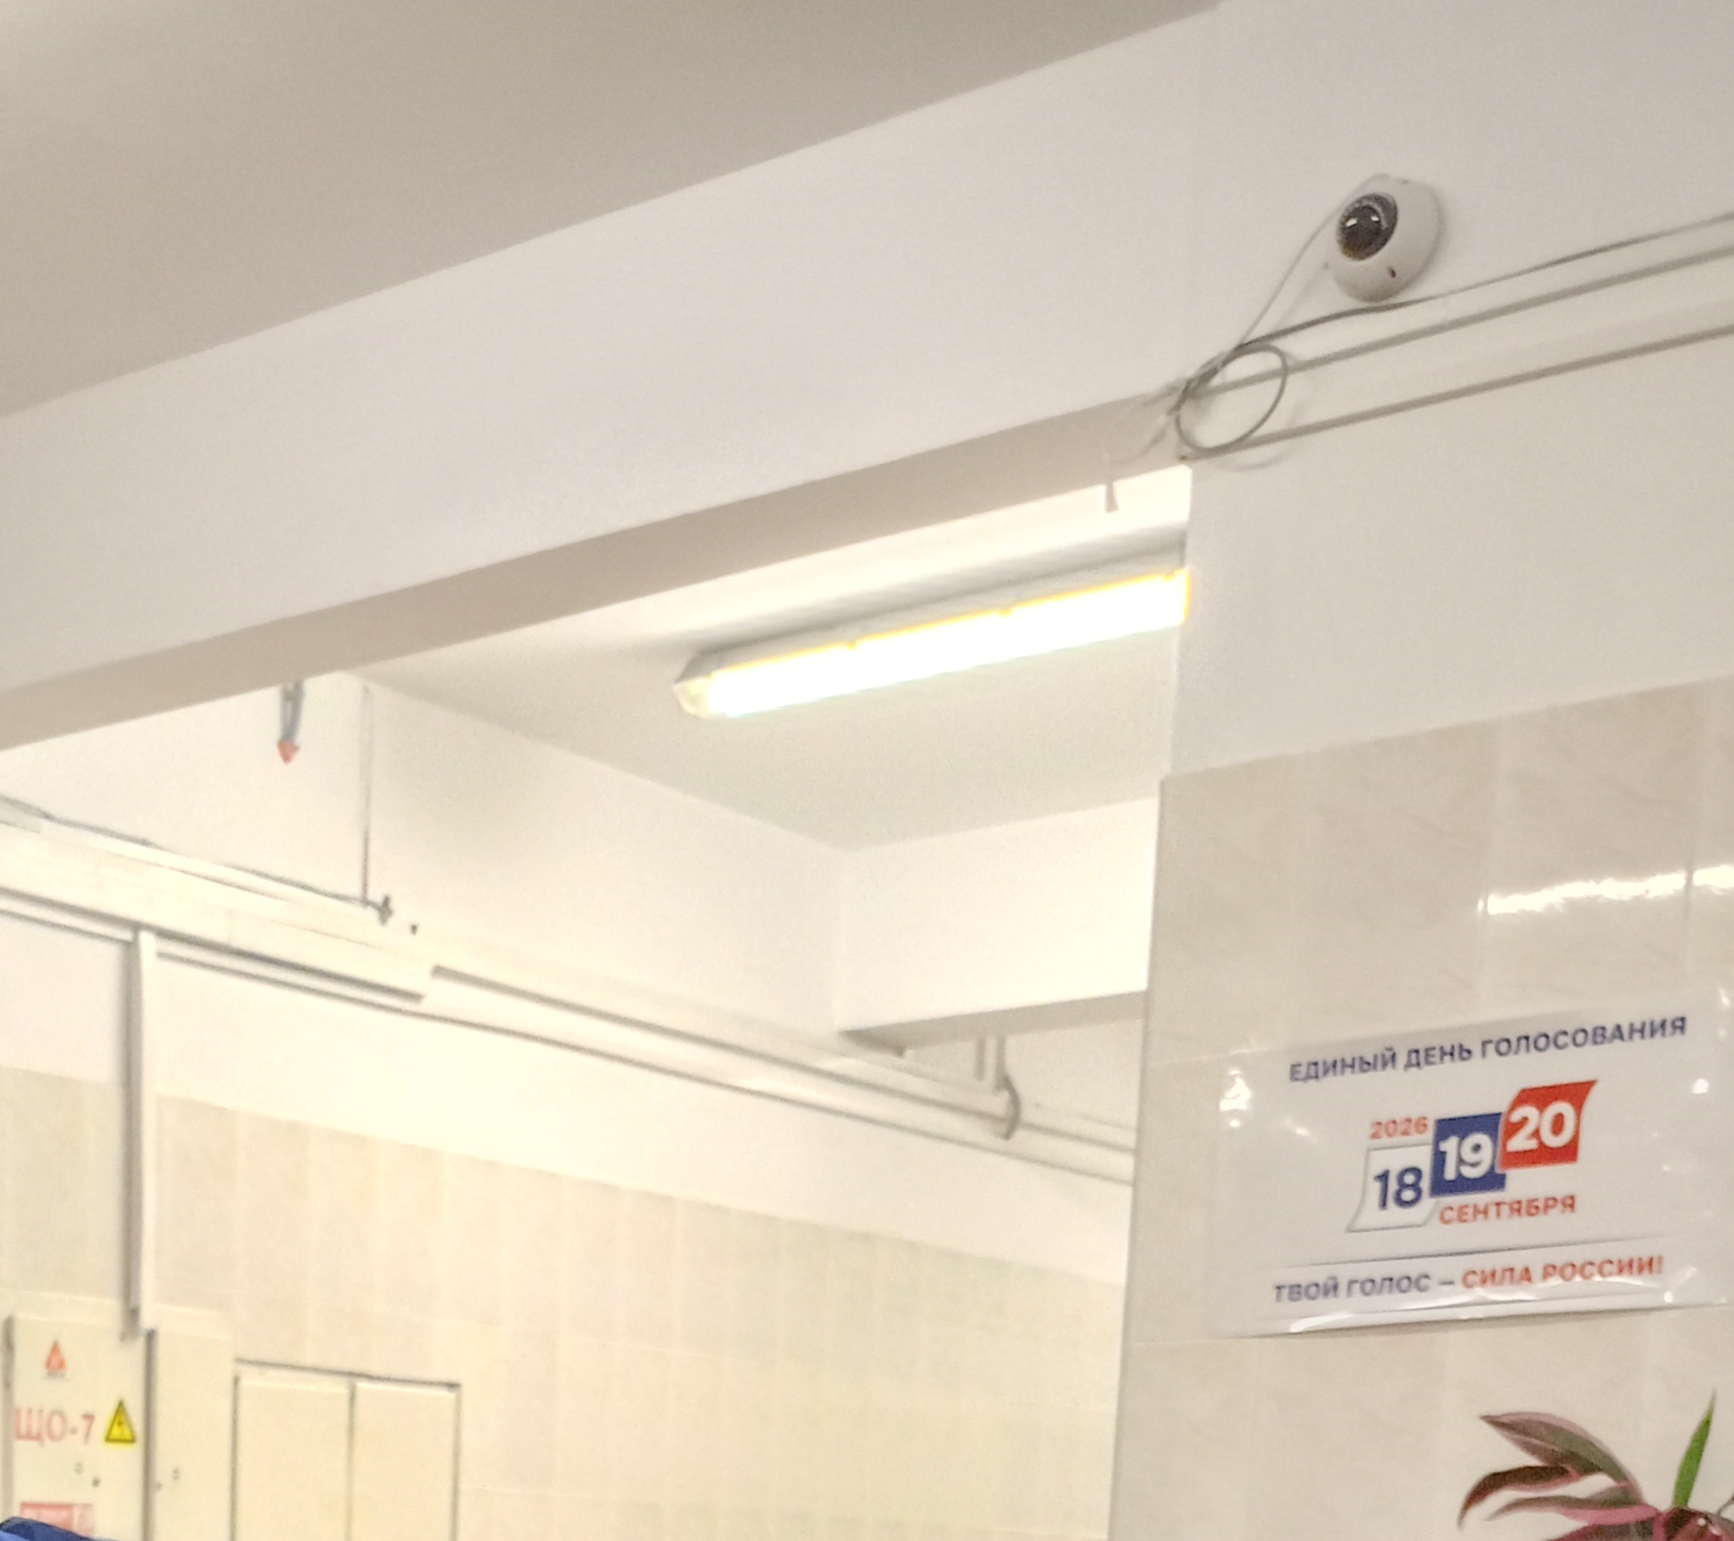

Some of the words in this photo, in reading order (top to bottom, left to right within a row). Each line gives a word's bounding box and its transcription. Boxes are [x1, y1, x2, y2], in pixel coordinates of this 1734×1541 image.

[1289, 1047, 1396, 1083] ЕДИНЫЙ
[1403, 1044, 1472, 1071] ДЕНЬ
[1481, 1016, 1686, 1059] ГОЛОСОВАНИЯ
[1370, 1116, 1428, 1139] 2026
[1373, 1167, 1423, 1210] 18
[1439, 1132, 1493, 1181] 19
[1507, 1101, 1576, 1151] 20
[1440, 1195, 1576, 1225] СЕНТЯБРЯ
[1273, 1276, 1339, 1303] ТВОЙ
[1347, 1273, 1431, 1297] ГОЛОС
[1461, 1265, 1533, 1290] СИЛА
[1542, 1255, 1664, 1283] РОССИИ!
